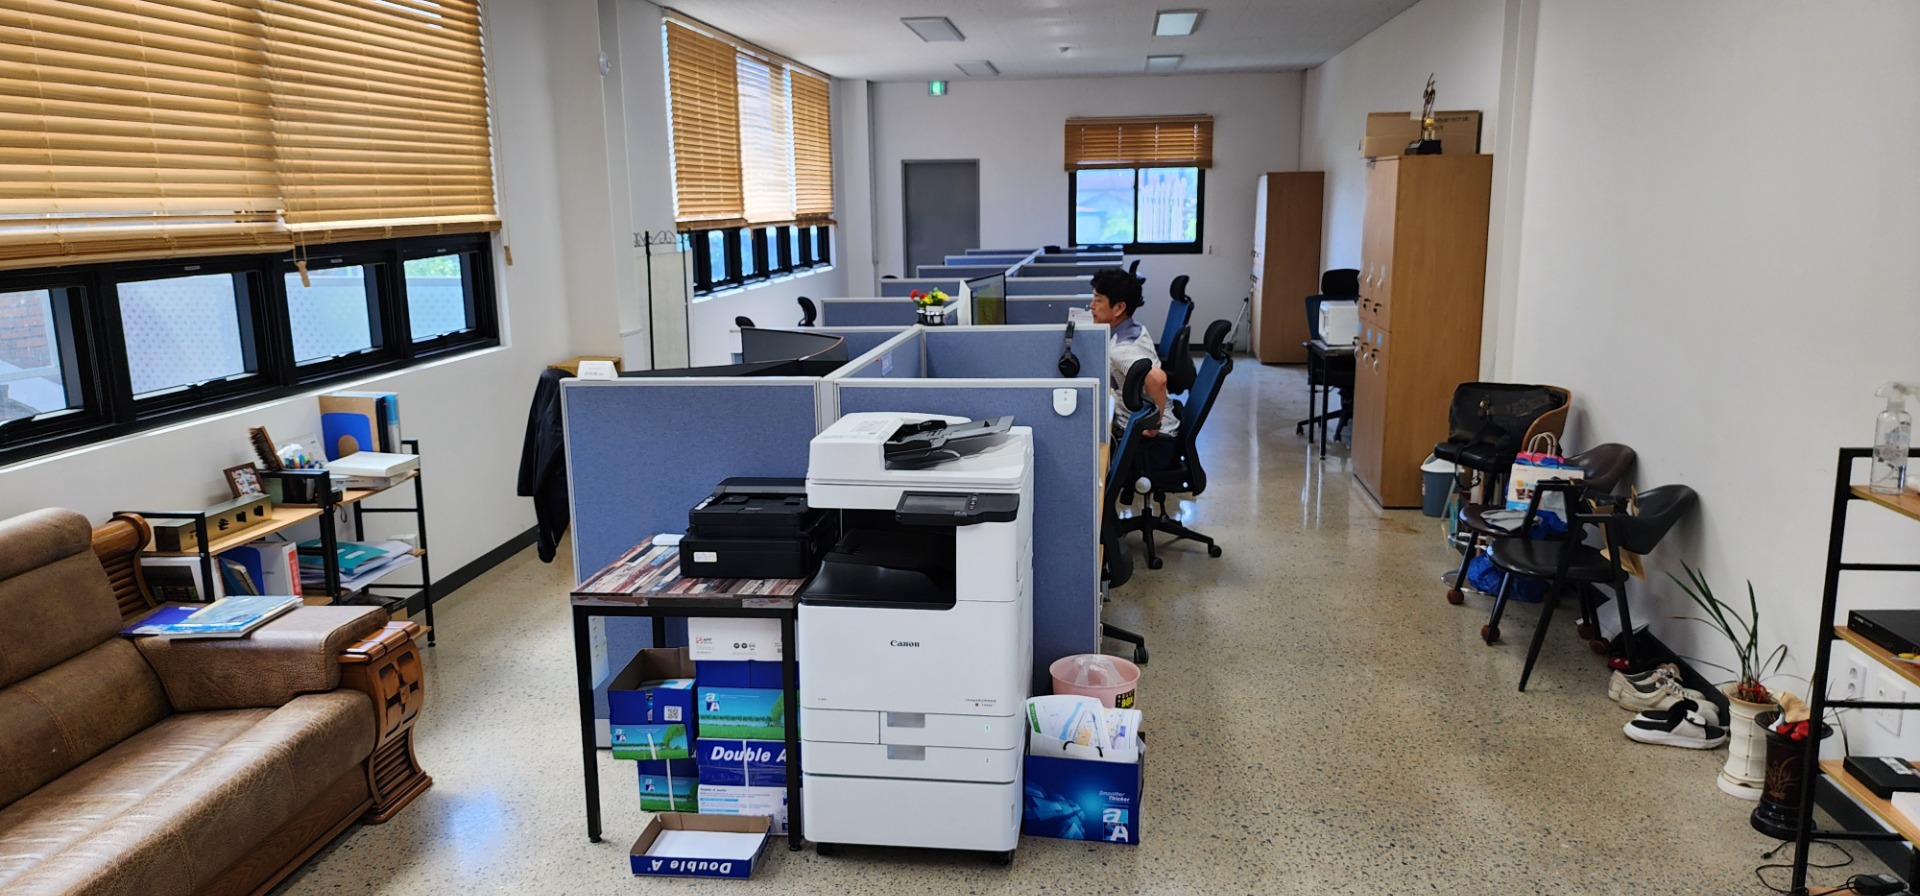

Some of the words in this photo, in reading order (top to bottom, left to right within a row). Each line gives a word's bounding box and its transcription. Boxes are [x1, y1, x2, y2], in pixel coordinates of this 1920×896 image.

[890, 639, 920, 648] Canon
[710, 745, 771, 763] Double
[776, 748, 787, 763] A
[651, 859, 663, 871] A
[669, 859, 732, 874] Double
